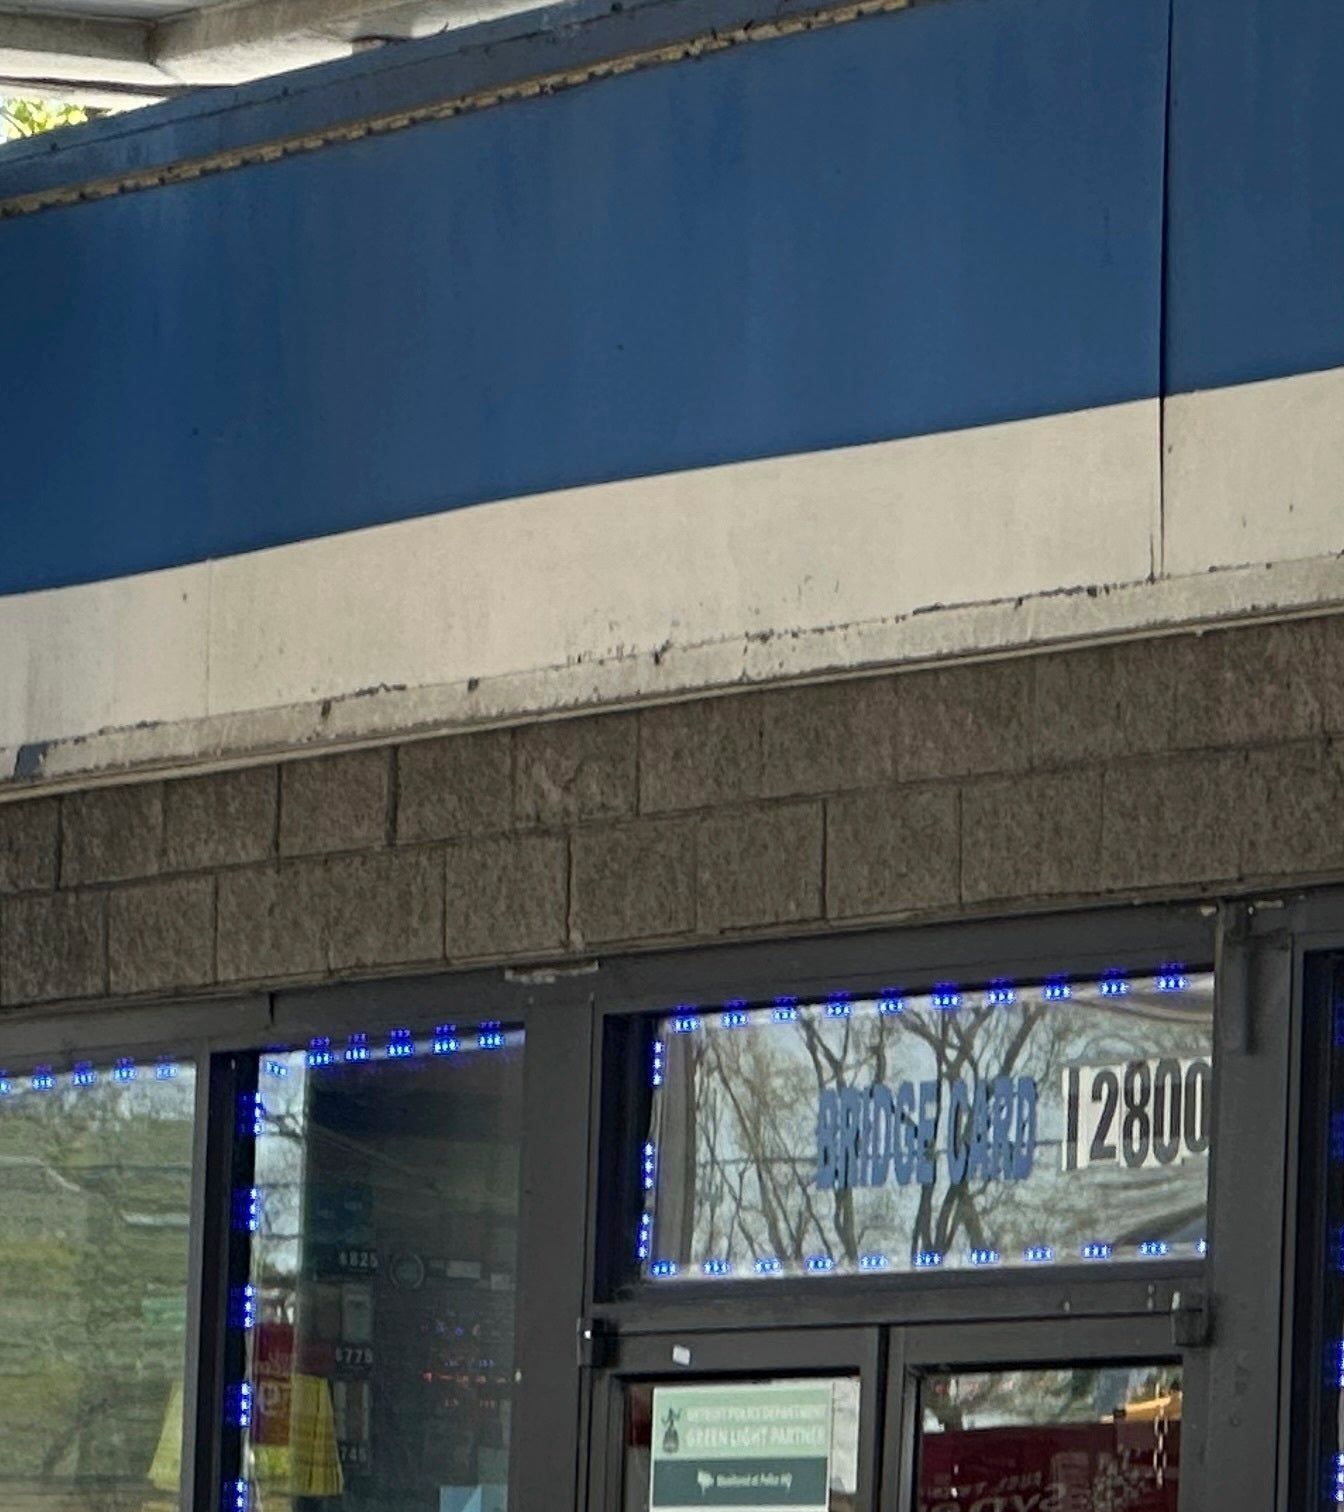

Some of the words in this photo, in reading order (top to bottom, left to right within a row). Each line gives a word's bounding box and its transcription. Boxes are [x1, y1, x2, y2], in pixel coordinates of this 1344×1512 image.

[816, 1079, 937, 1190] BRIDGE
[948, 1074, 1038, 1185] CARD
[1067, 1058, 1210, 1171] 12800
